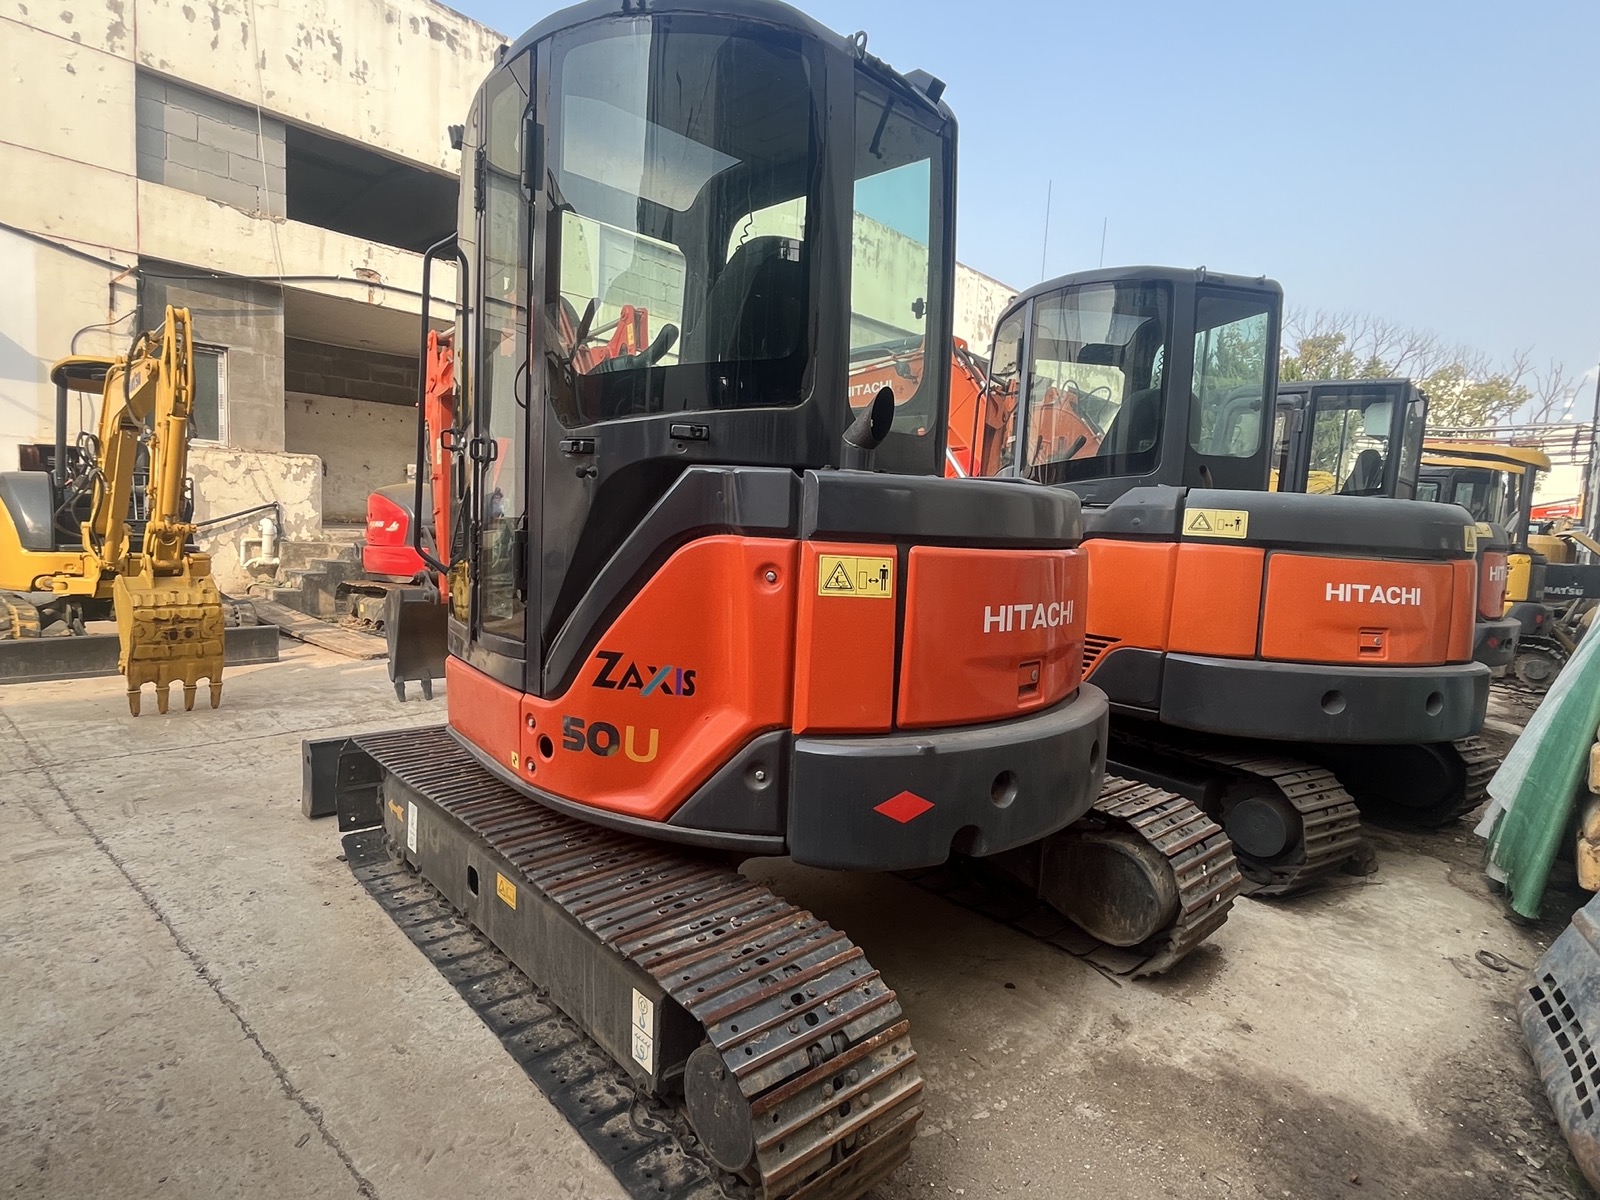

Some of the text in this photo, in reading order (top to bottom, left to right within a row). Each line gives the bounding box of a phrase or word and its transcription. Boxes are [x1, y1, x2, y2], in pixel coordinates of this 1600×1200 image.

[1325, 582, 1421, 606] HITACHI
[1543, 586, 1584, 596] MATSU
[983, 599, 1074, 633] HITACHI
[591, 650, 696, 697] ZAXIS
